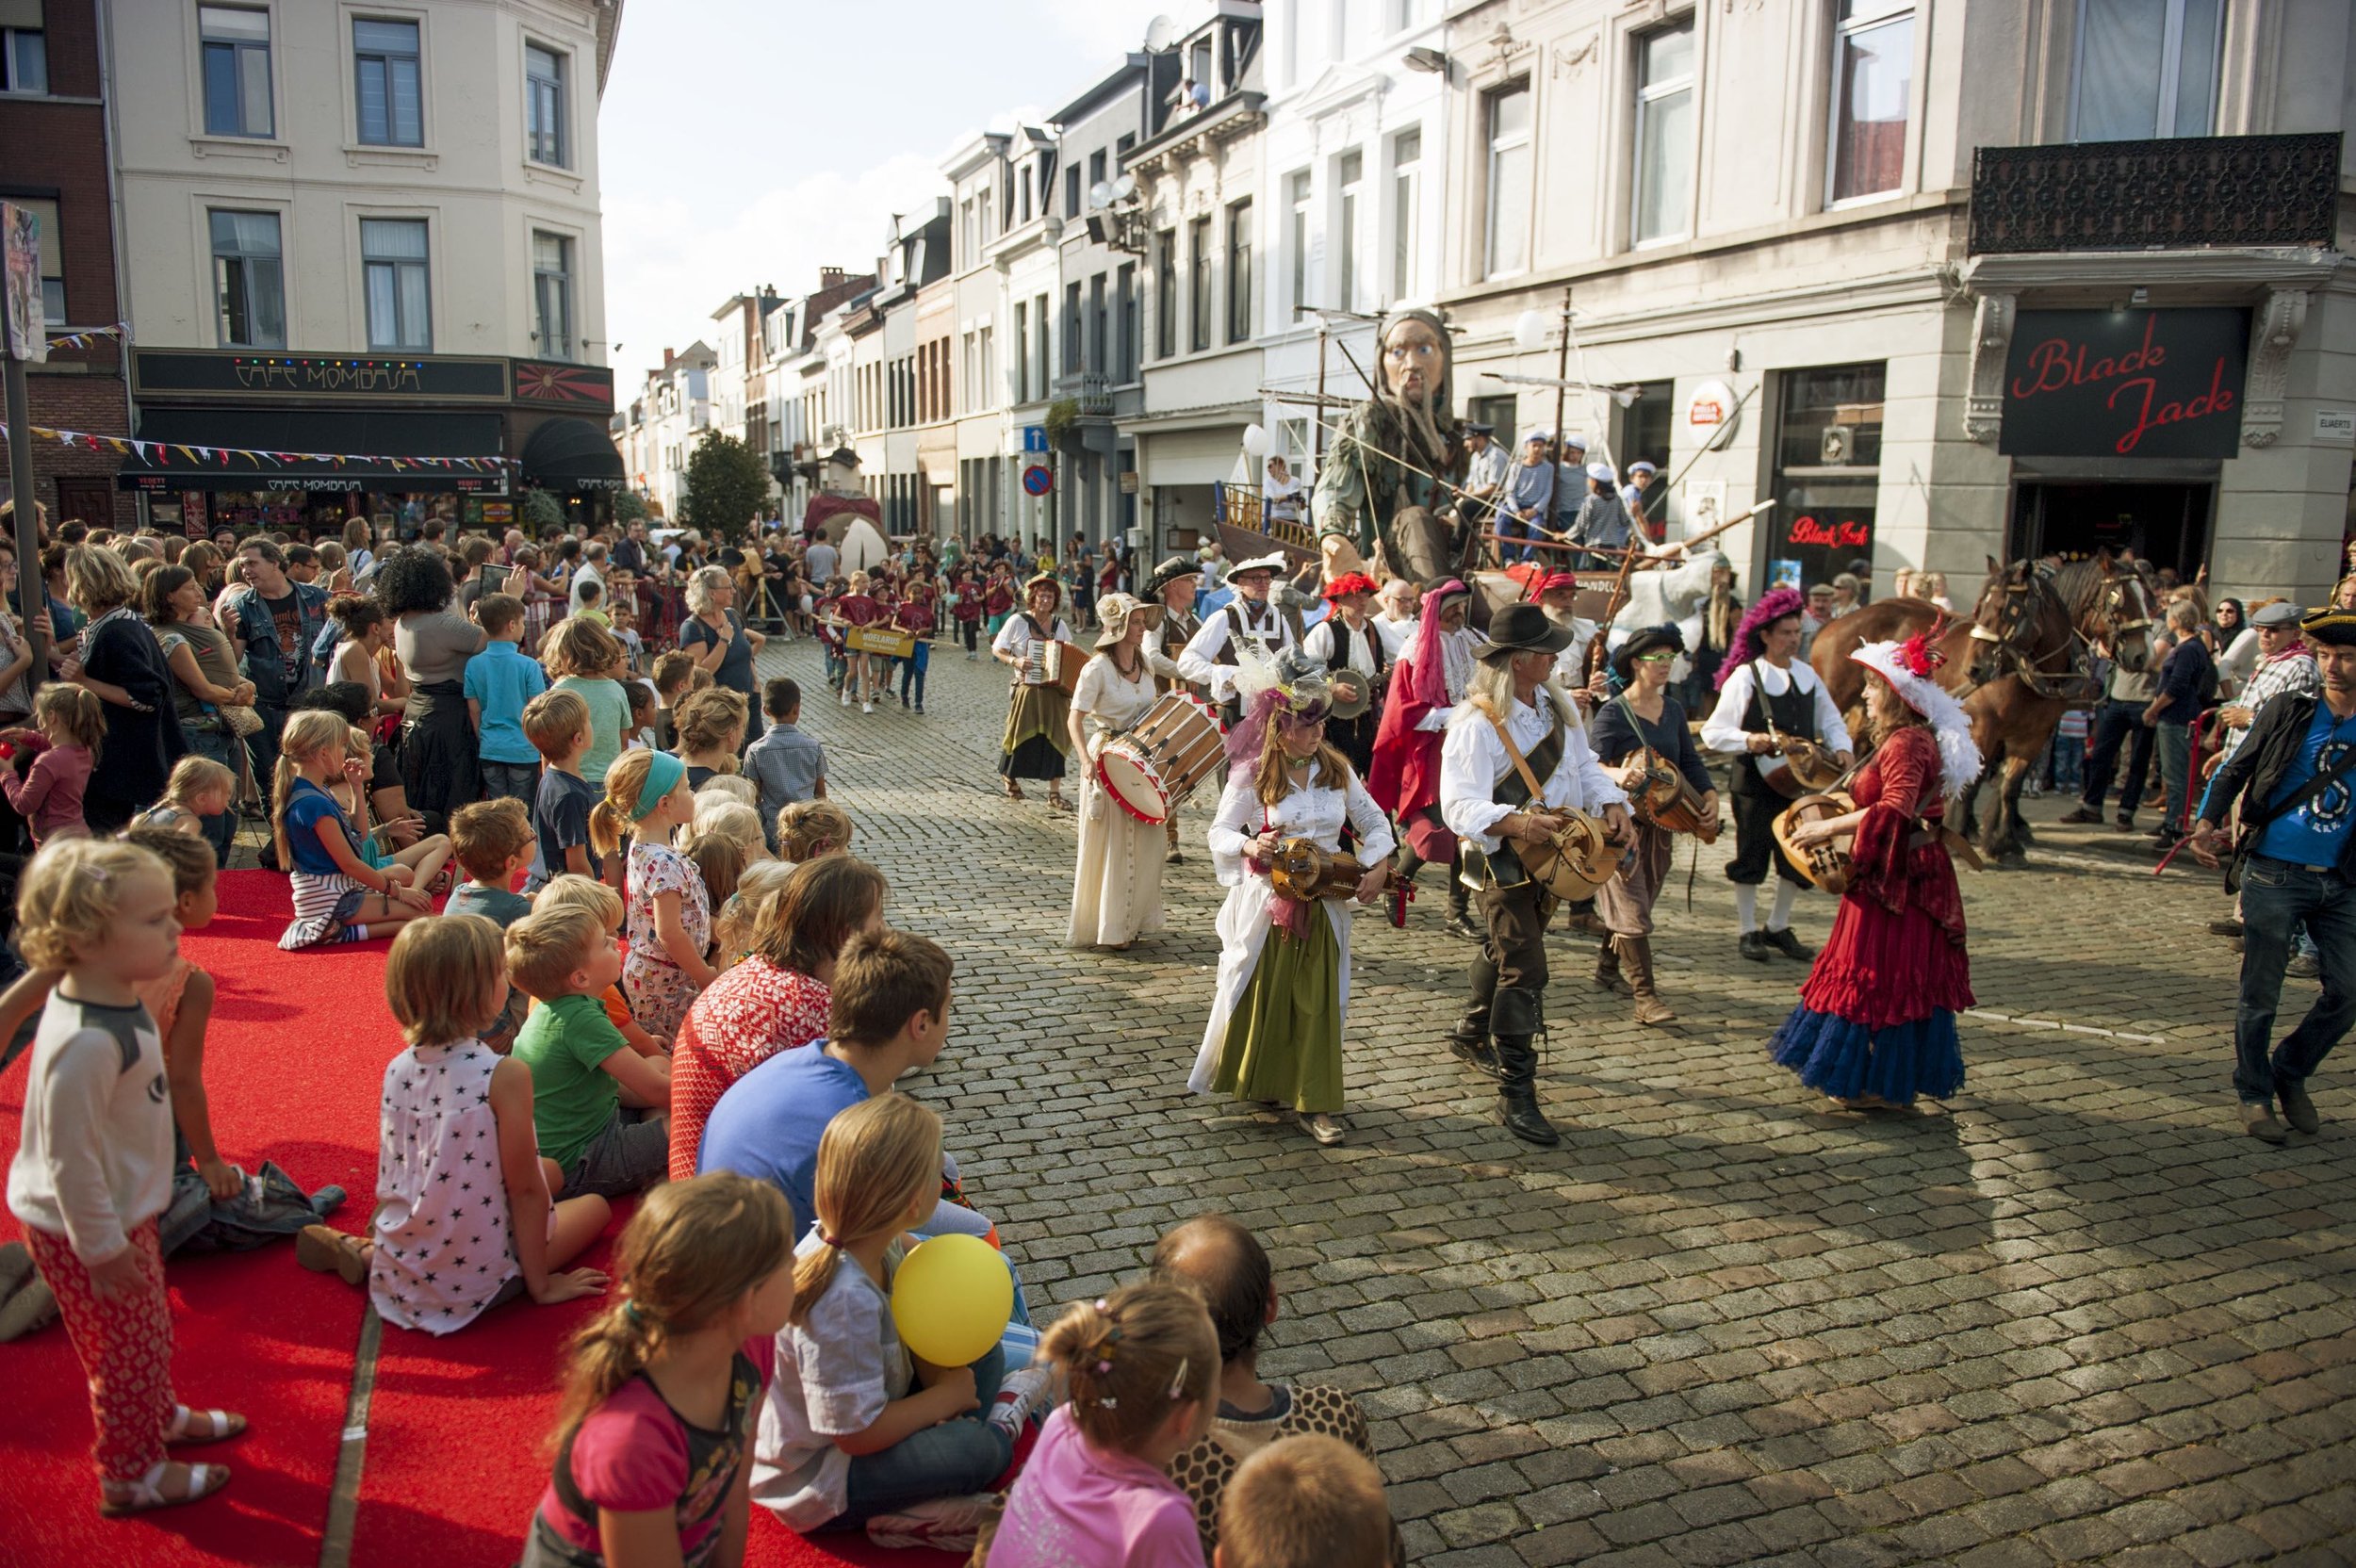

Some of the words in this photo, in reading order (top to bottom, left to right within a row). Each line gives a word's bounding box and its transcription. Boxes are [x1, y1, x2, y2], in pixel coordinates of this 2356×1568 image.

[2012, 312, 2167, 400] Black
[307, 368, 420, 390] MOMBASA
[2107, 356, 2234, 454] Jack
[303, 480, 362, 492] MOMBASA
[1788, 515, 1837, 546] Black
[1833, 520, 1869, 548] Jack
